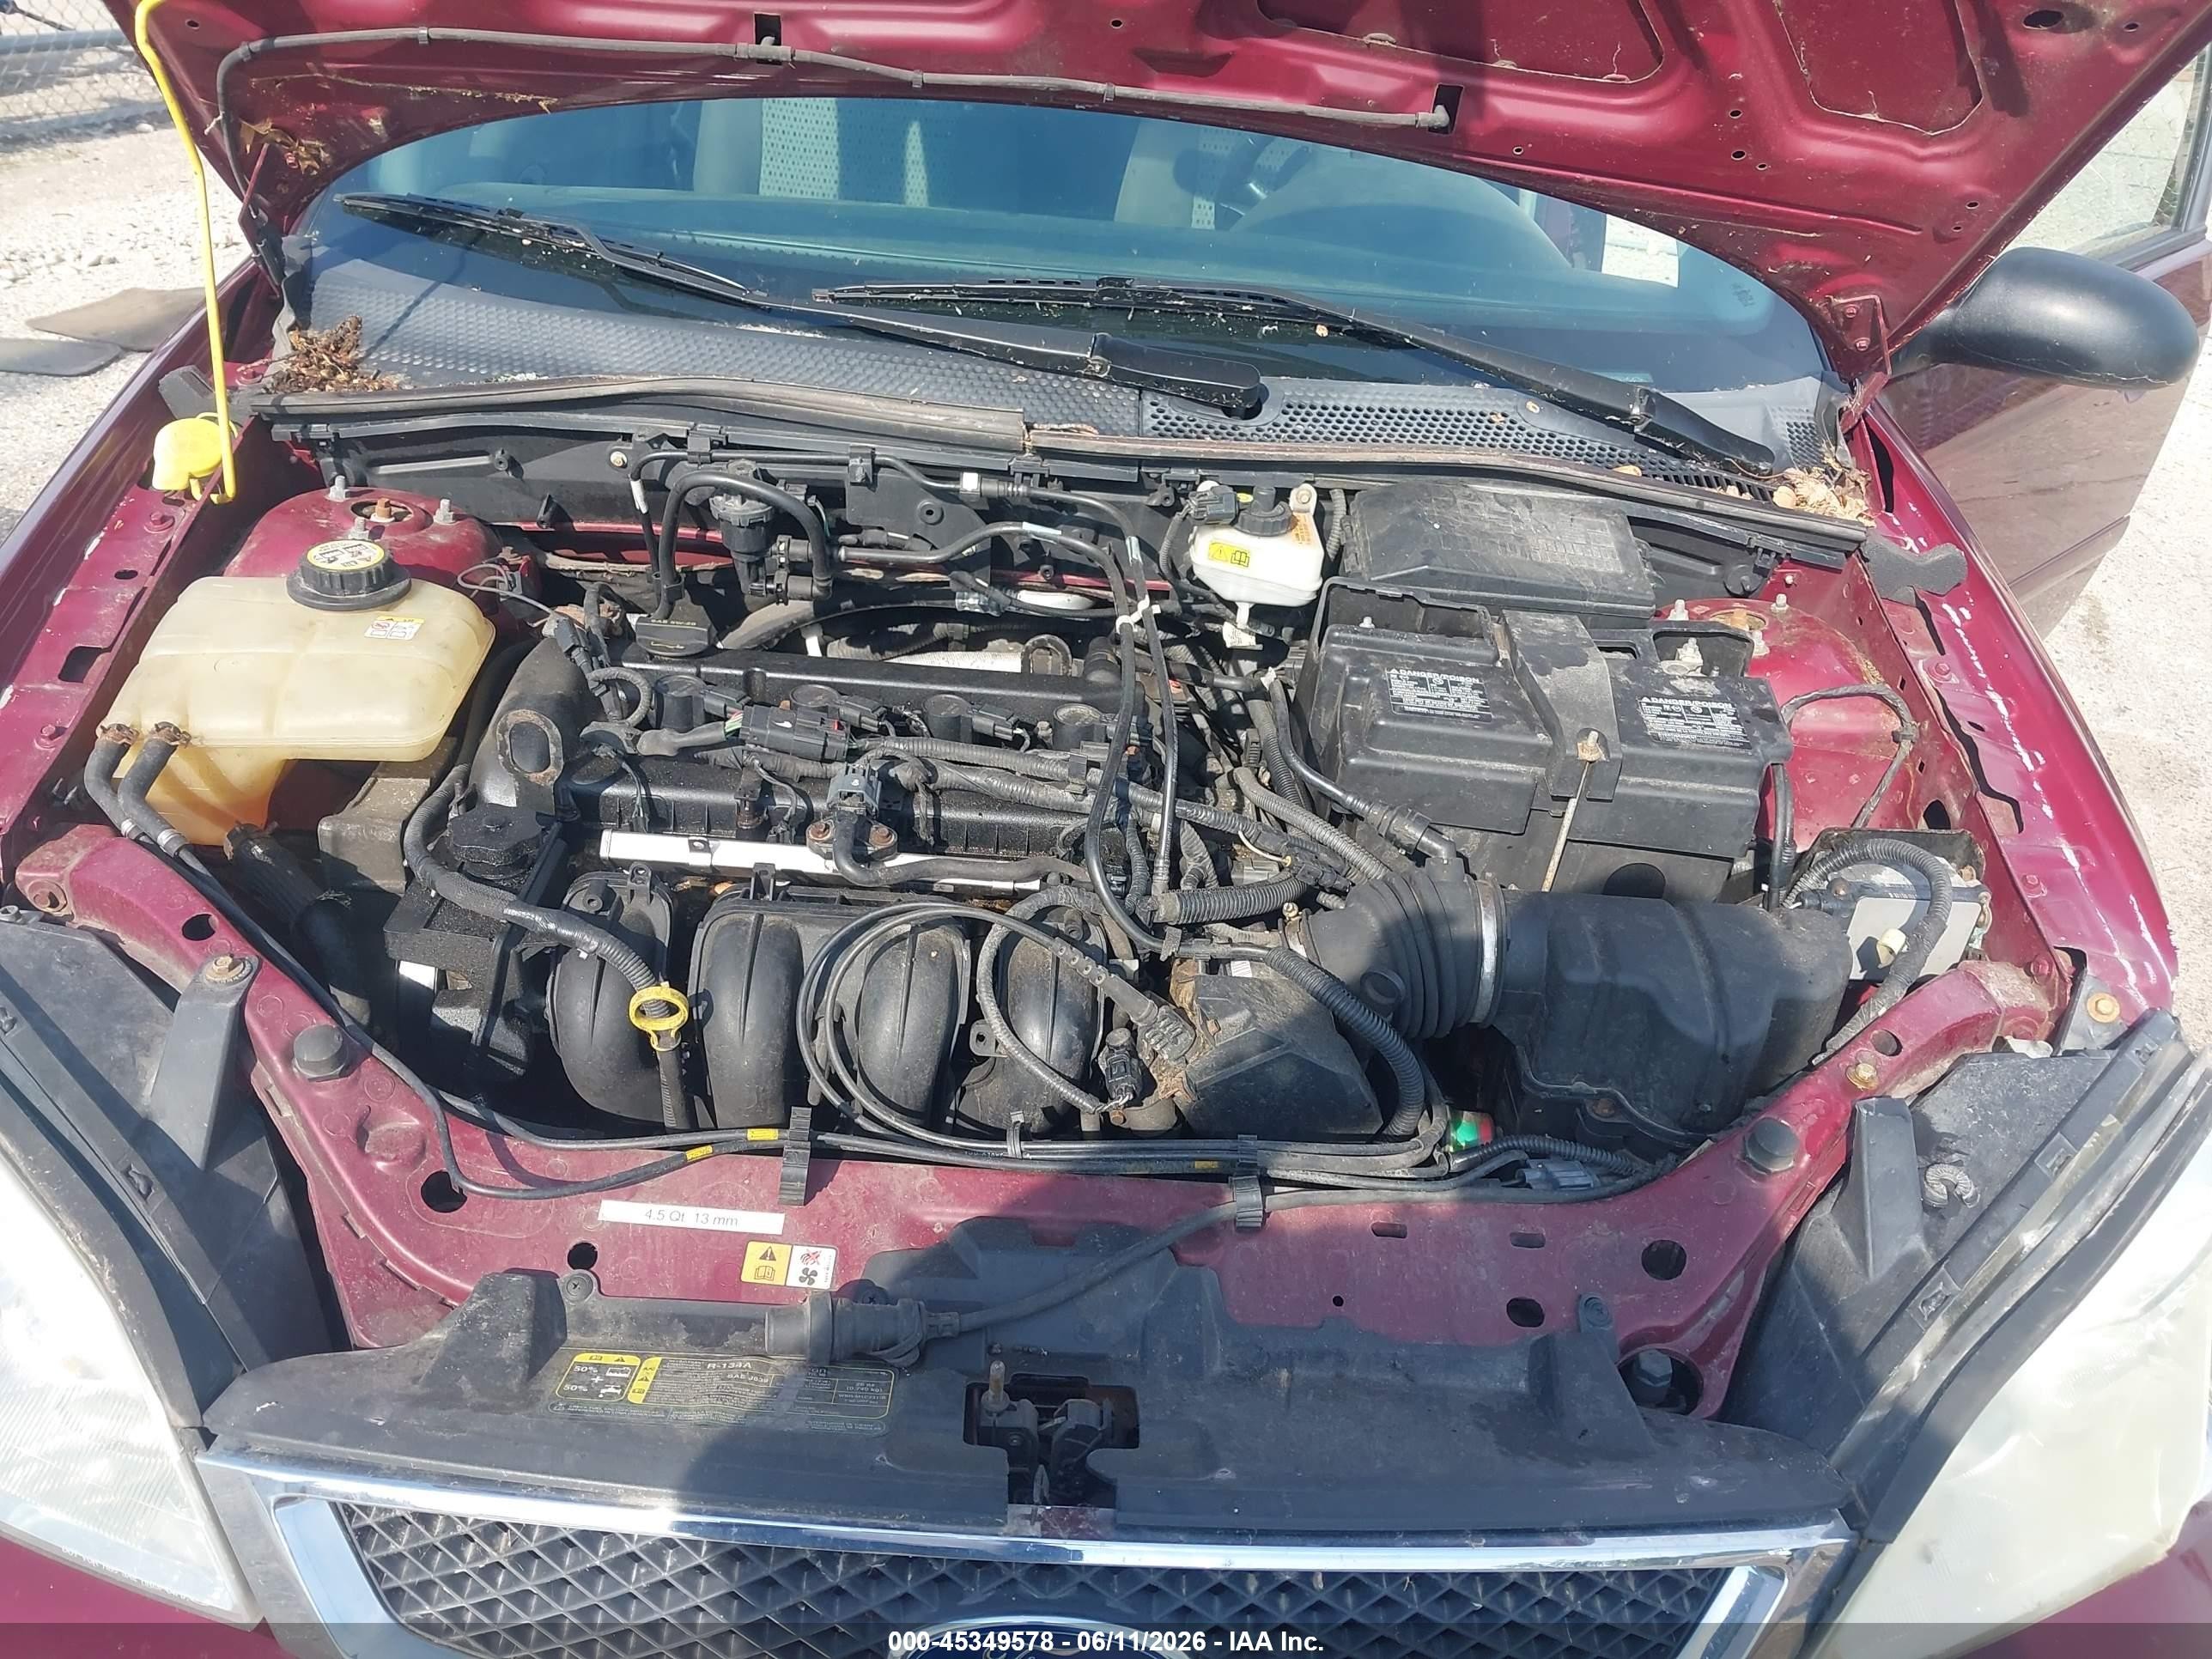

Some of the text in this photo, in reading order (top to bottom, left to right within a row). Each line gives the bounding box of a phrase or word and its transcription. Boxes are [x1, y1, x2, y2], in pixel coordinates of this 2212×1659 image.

[645, 1209, 738, 1228] 4.5 Qt 13 mm
[573, 1365, 599, 1374] 50%
